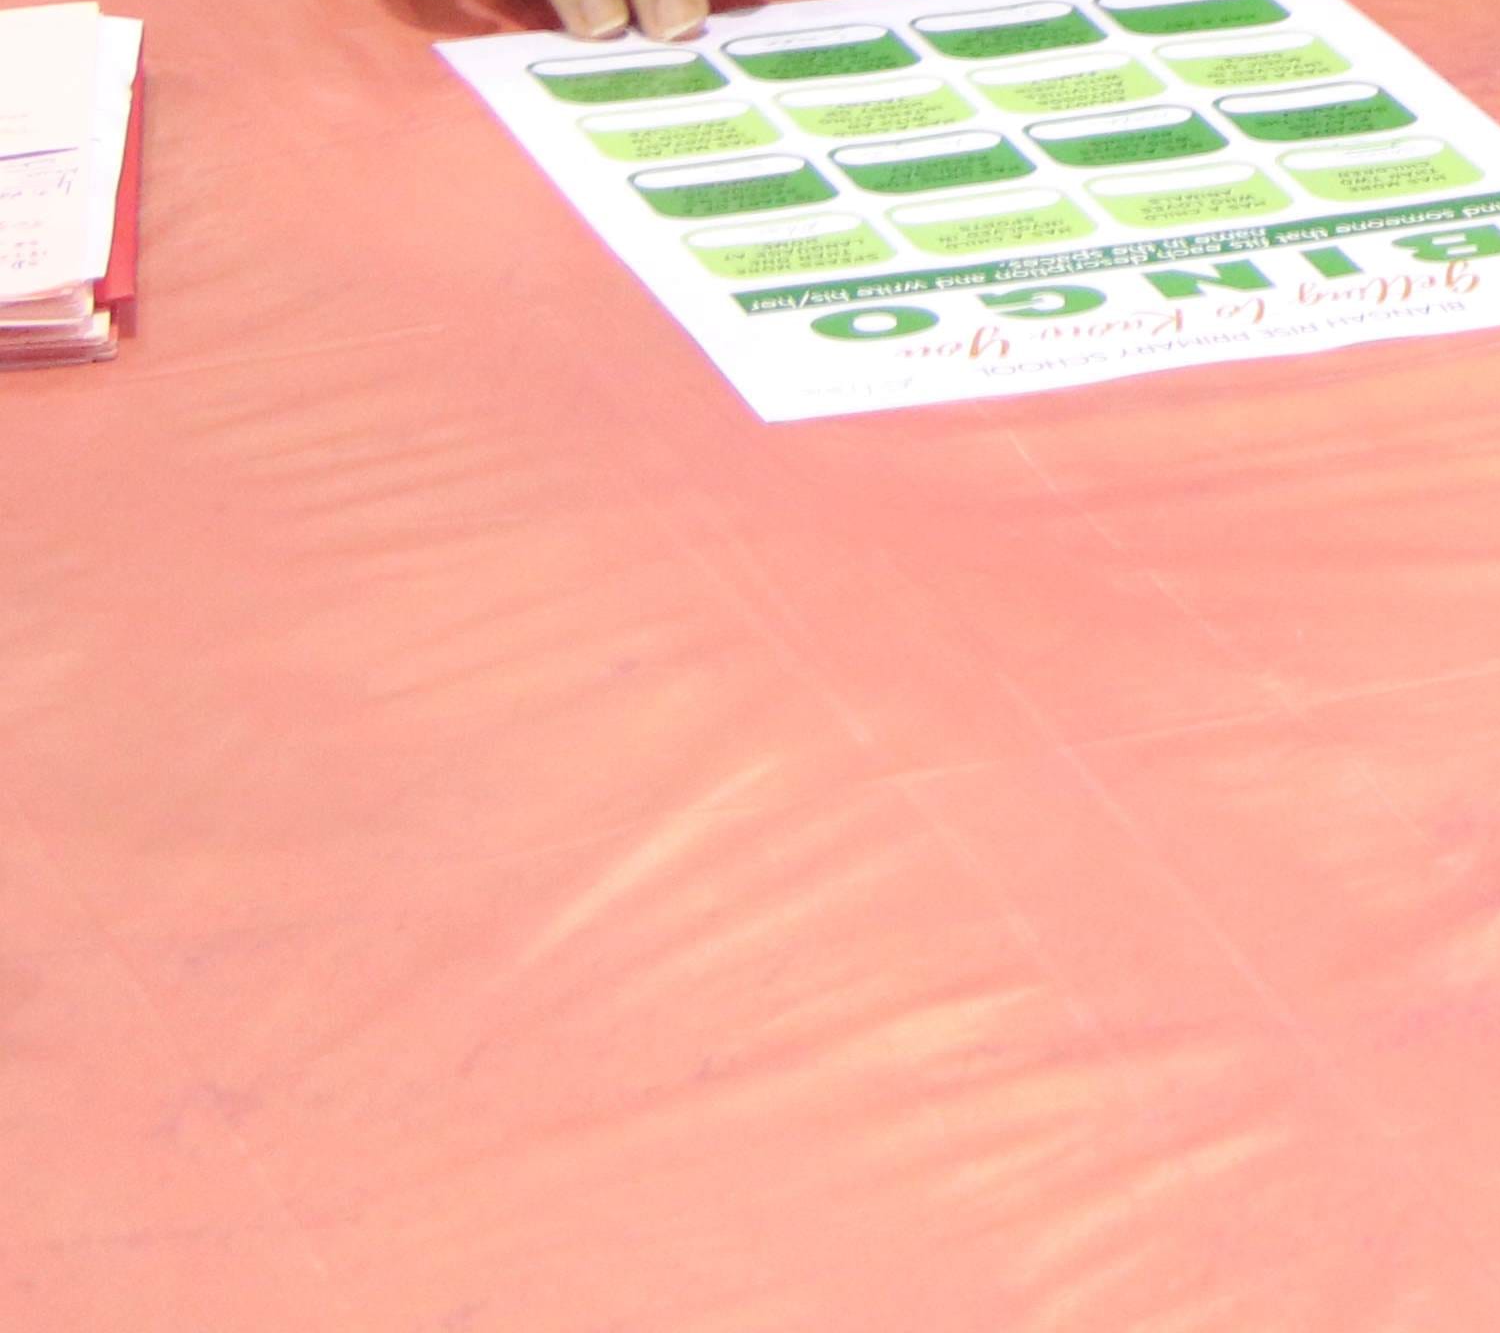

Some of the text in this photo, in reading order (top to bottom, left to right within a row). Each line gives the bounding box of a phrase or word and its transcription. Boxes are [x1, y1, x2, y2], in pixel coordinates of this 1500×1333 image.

[1329, 208, 1452, 235] someone
[1221, 235, 1276, 251] fits
[1274, 226, 1331, 245] that
[992, 225, 1272, 271] name in the spaces.
[1150, 240, 1227, 261] each
[984, 249, 1157, 282] description
[847, 279, 923, 301] write
[925, 270, 993, 290] and
[747, 288, 845, 310] his/her
[901, 261, 1481, 360] Getting to Know You
